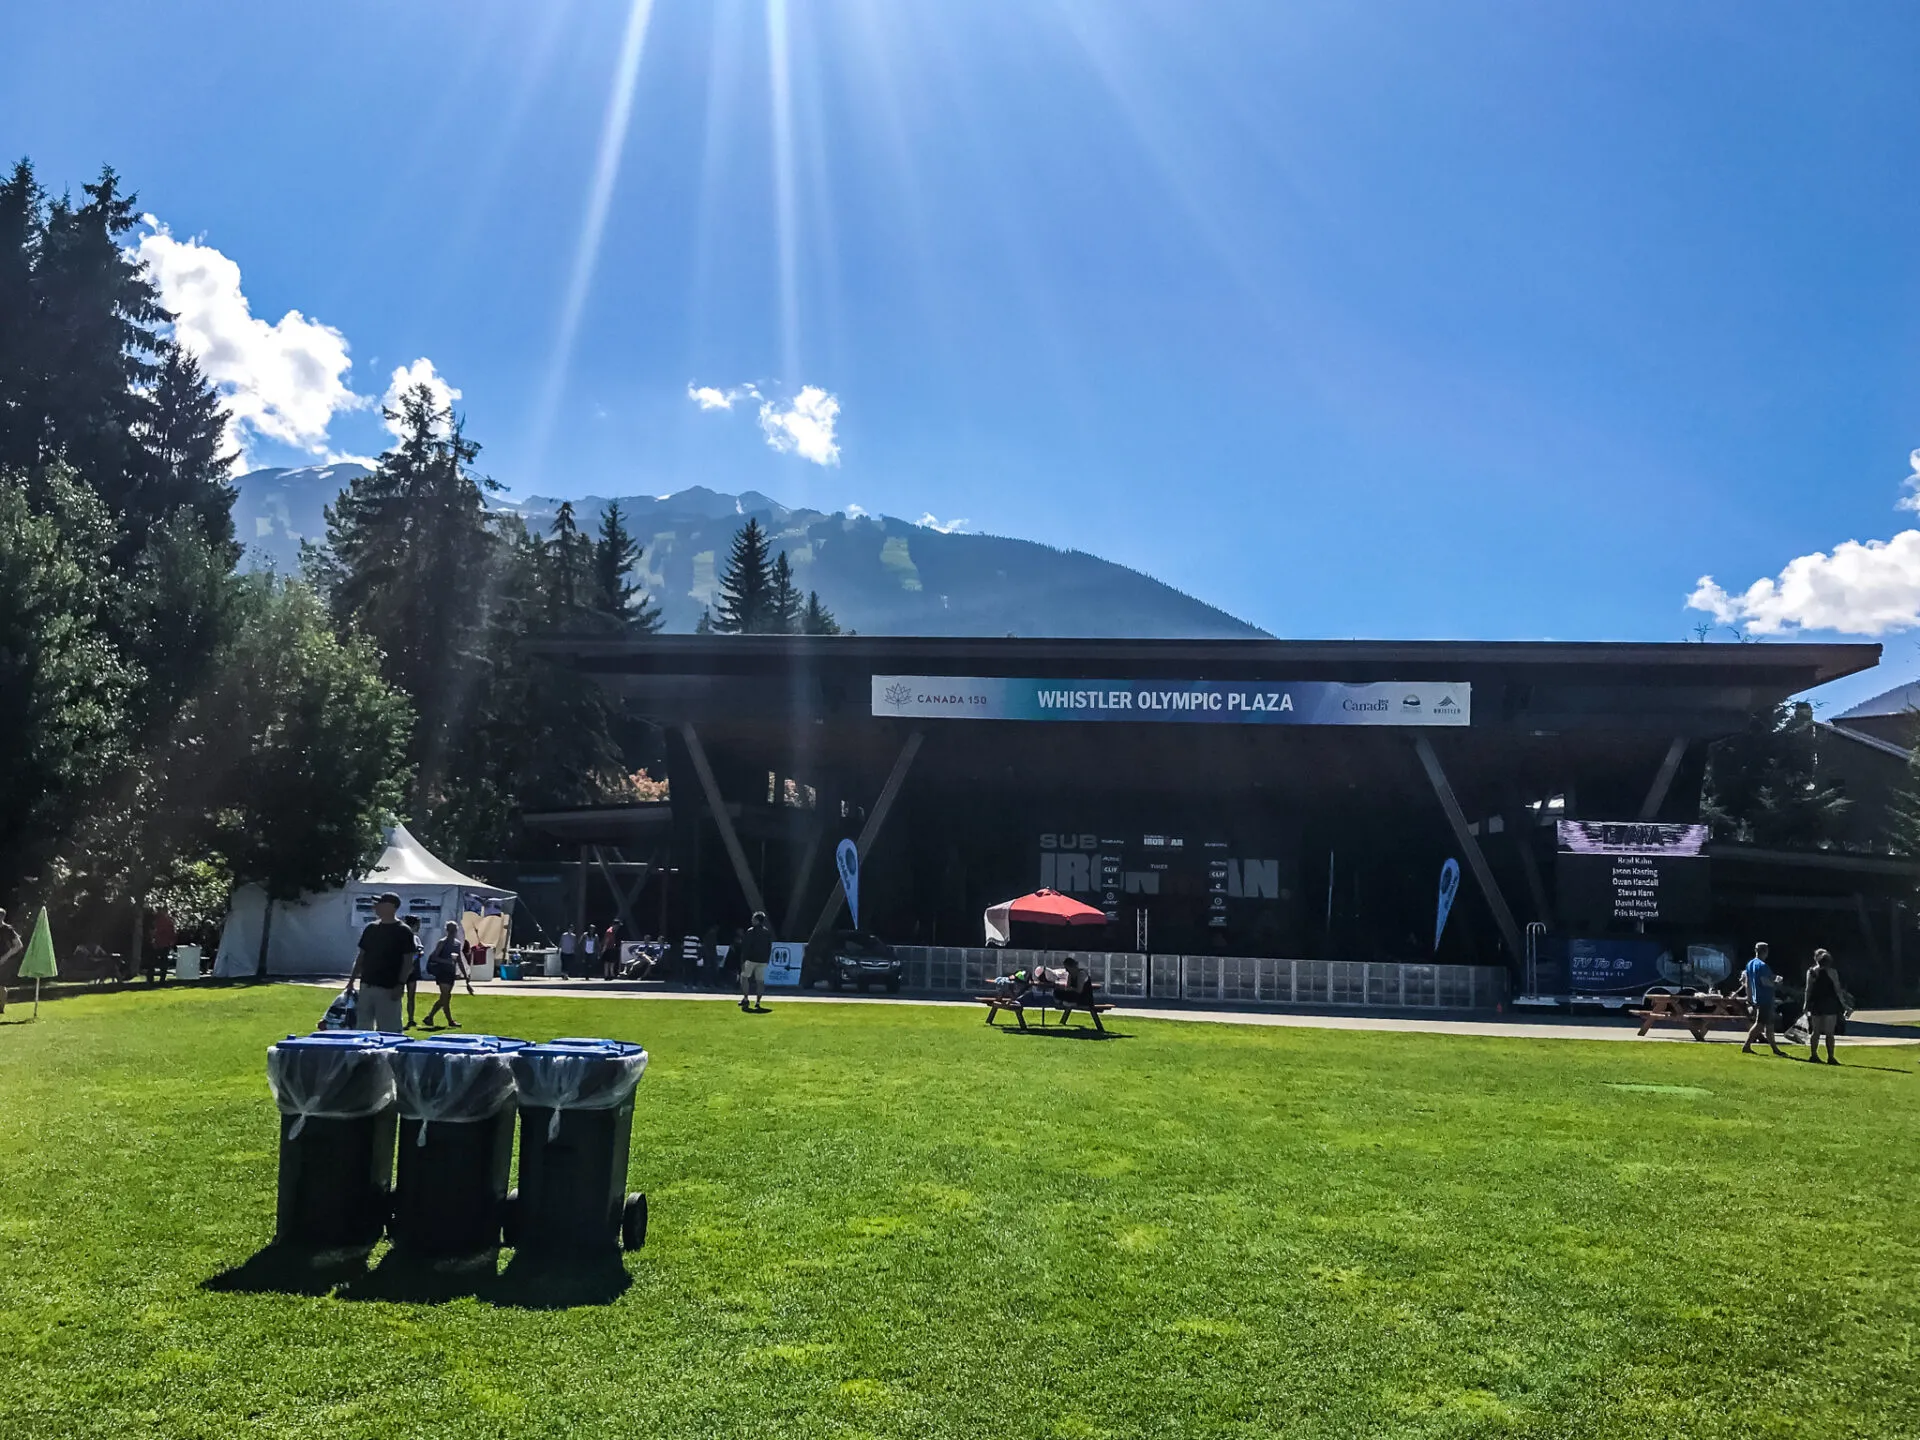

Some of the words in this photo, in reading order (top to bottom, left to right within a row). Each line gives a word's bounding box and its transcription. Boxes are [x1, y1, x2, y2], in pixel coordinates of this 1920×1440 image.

[917, 694, 964, 704] CANADA
[968, 696, 987, 705] 150
[1037, 690, 1132, 709] WHISTLER
[1138, 691, 1222, 710] OLYMPIC
[1228, 693, 1294, 711] PLAZA
[1342, 699, 1388, 711] Canada
[1612, 877, 1632, 886] Owen
[1617, 888, 1637, 897] Steve
[1573, 957, 1592, 968] TV
[1594, 957, 1610, 969] To
[1613, 958, 1632, 969] Go
